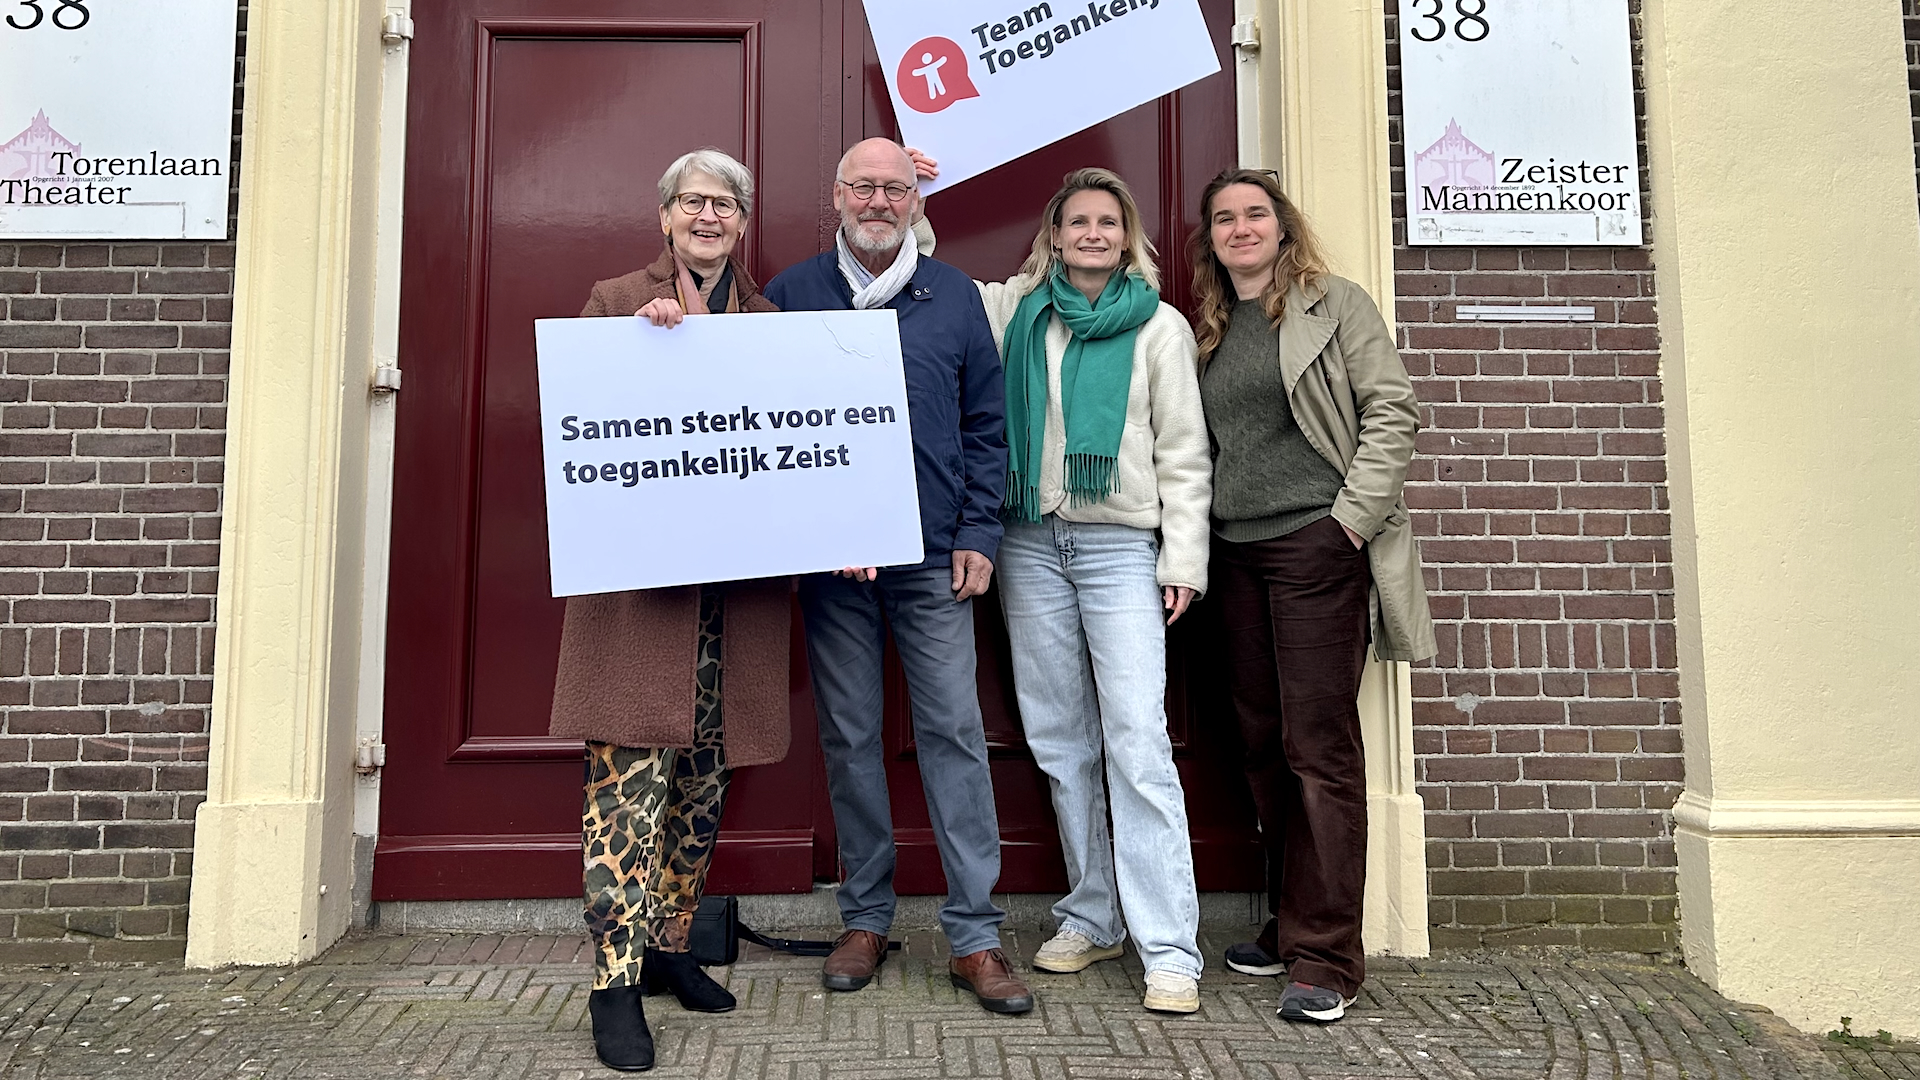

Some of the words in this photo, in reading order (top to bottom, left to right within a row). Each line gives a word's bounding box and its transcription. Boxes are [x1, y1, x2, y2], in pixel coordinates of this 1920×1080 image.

[5, 0, 90, 30] 38
[971, 1, 1054, 49] Team
[1410, 0, 1490, 42] 38
[979, 0, 1159, 75] Toeganke
[51, 150, 222, 176] Torenlaan
[1501, 157, 1629, 184] Zeister
[0, 179, 132, 205] Theater
[1421, 185, 1631, 211] Mannenkoor
[561, 415, 673, 441] Samen
[681, 405, 762, 434] sterk
[767, 408, 836, 429] voor
[843, 405, 896, 425] een
[562, 447, 771, 488] toegankelijk
[776, 443, 850, 471] Zeist
